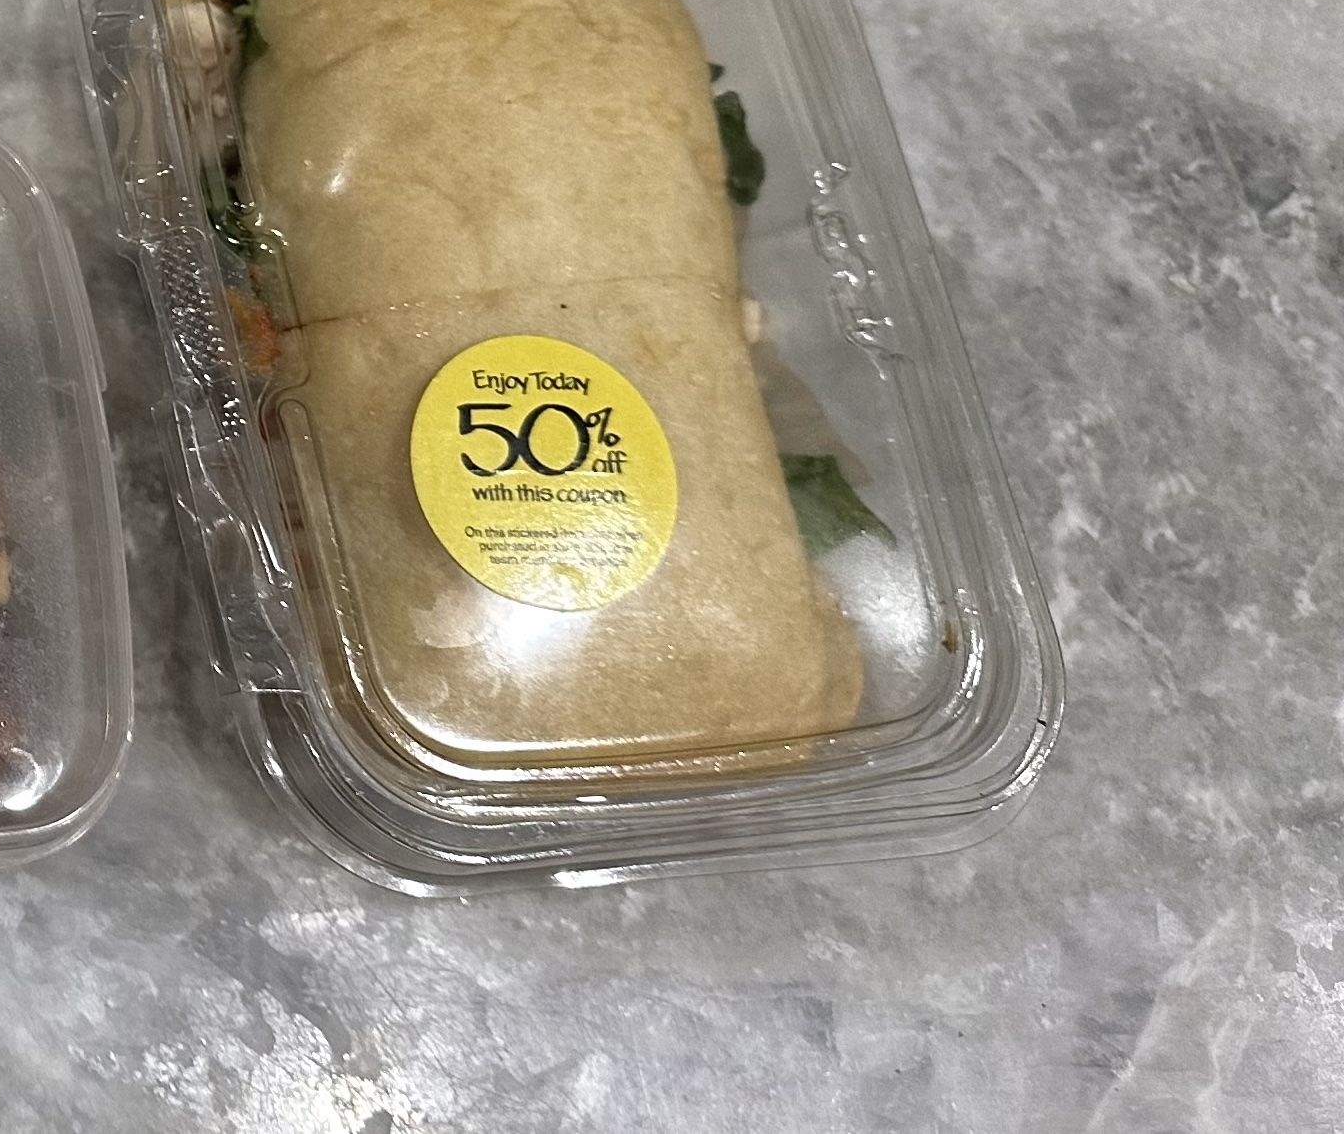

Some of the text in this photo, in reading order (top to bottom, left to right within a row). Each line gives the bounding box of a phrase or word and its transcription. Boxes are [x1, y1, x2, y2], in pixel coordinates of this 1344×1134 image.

[472, 370, 590, 395] Enjoy Today
[457, 403, 627, 477] 50% off
[472, 484, 627, 506] with this coupon
